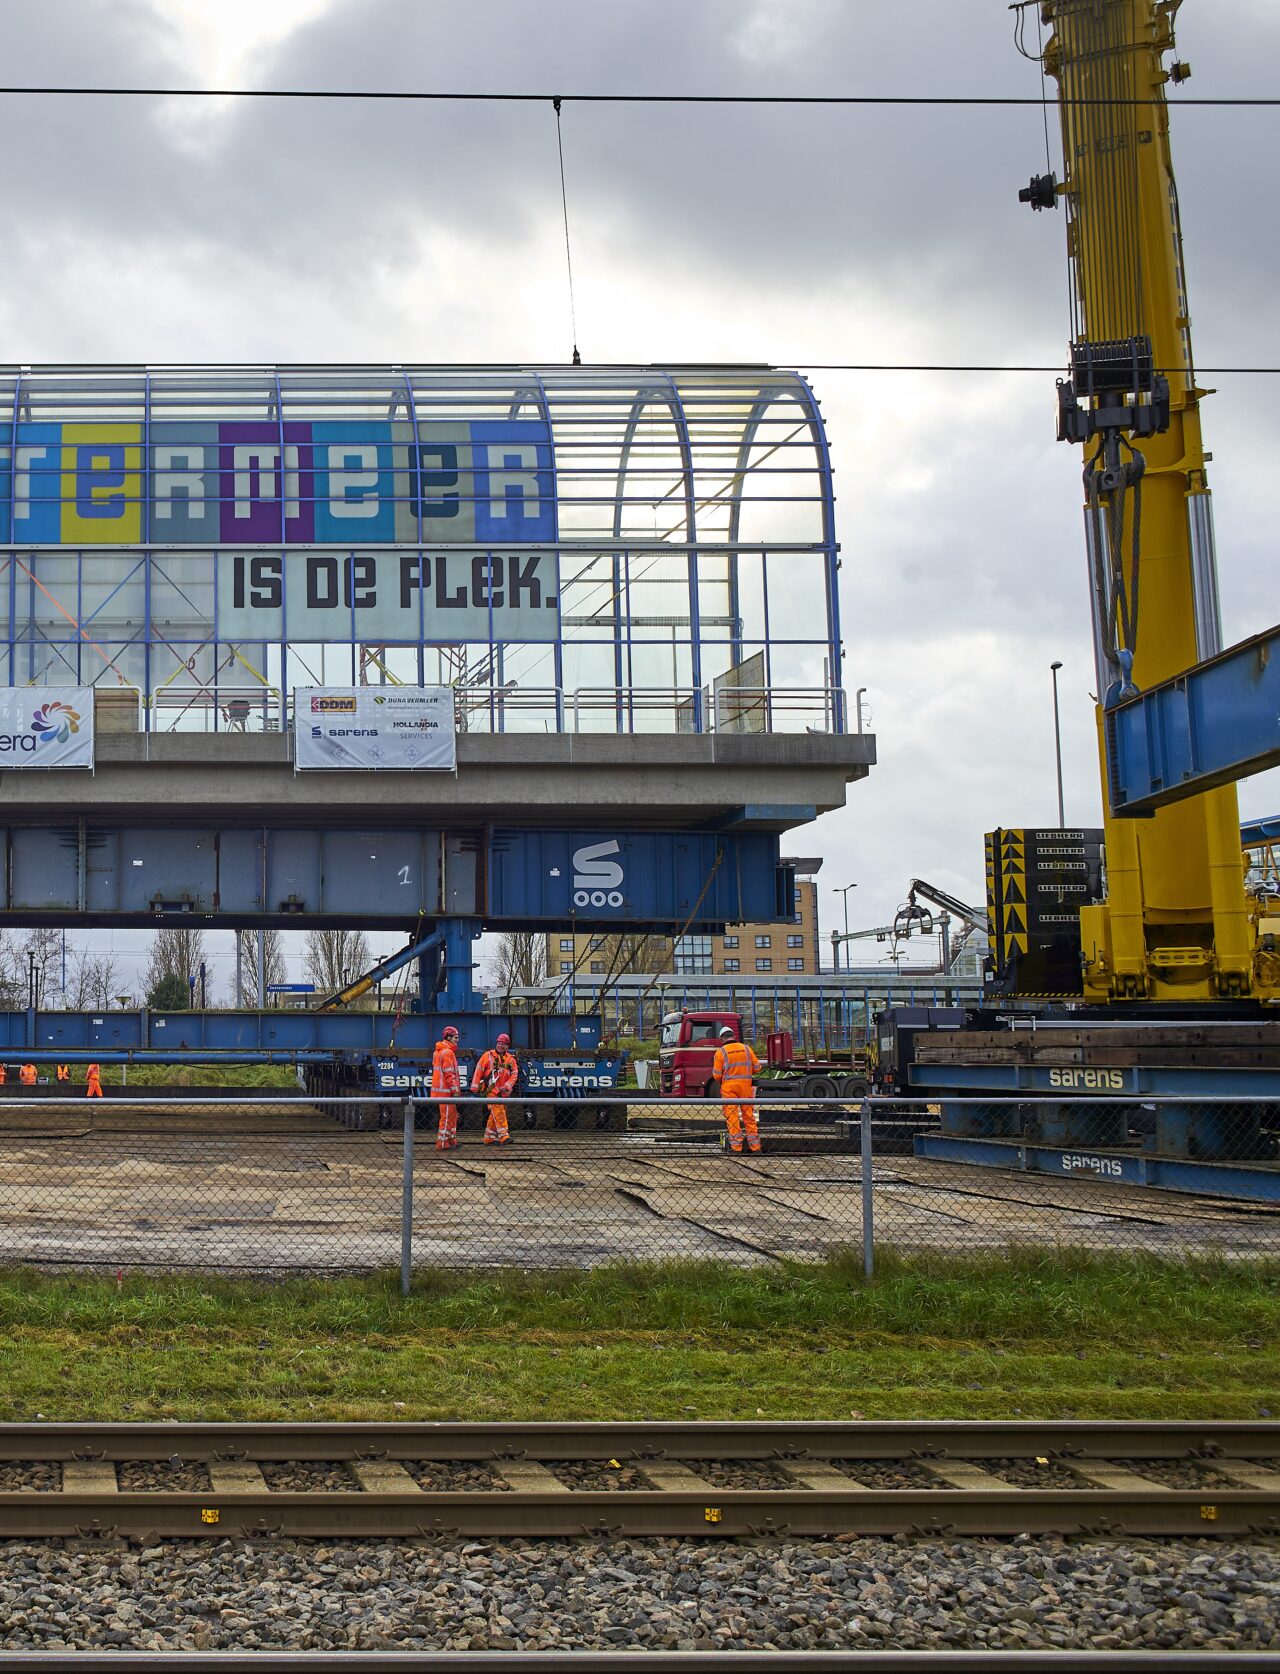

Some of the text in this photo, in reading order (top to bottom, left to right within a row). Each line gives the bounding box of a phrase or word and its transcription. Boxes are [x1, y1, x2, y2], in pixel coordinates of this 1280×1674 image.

[234, 557, 283, 609] IS
[320, 700, 353, 709] DDM
[328, 728, 379, 737] sarens
[399, 732, 433, 740] SERVICES
[398, 865, 413, 885] 1
[380, 1075, 468, 1087] sares
[528, 1075, 613, 1087] sarens
[1049, 1067, 1124, 1089] sarens
[1062, 1154, 1122, 1176] sarens
